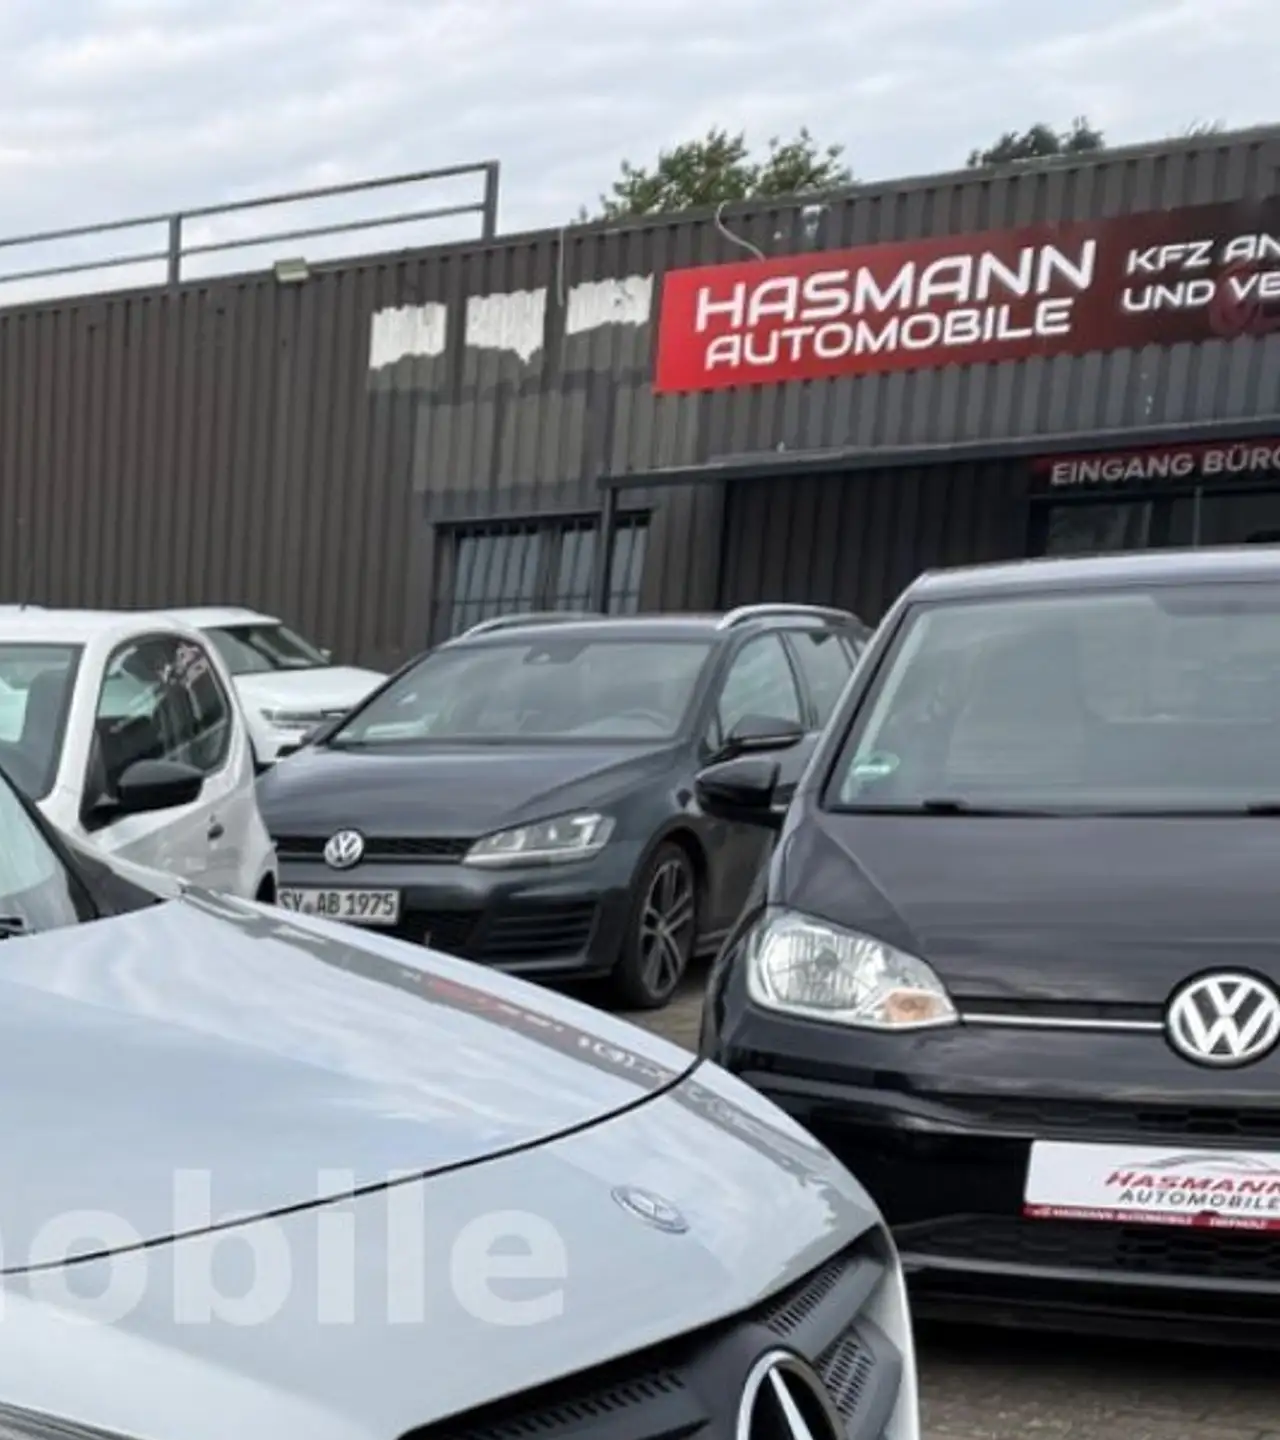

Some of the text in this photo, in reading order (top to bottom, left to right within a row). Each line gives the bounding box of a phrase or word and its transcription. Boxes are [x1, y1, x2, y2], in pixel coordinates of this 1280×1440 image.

[1126, 239, 1214, 275] KFZ
[695, 239, 1097, 332] HASMANN
[1122, 277, 1216, 312] UND
[704, 297, 1074, 370] AUTOMOBILE
[1050, 453, 1195, 486] EINGANG
[344, 892, 395, 916] 1975
[1119, 1189, 1280, 1211] AUTOMOBILE
